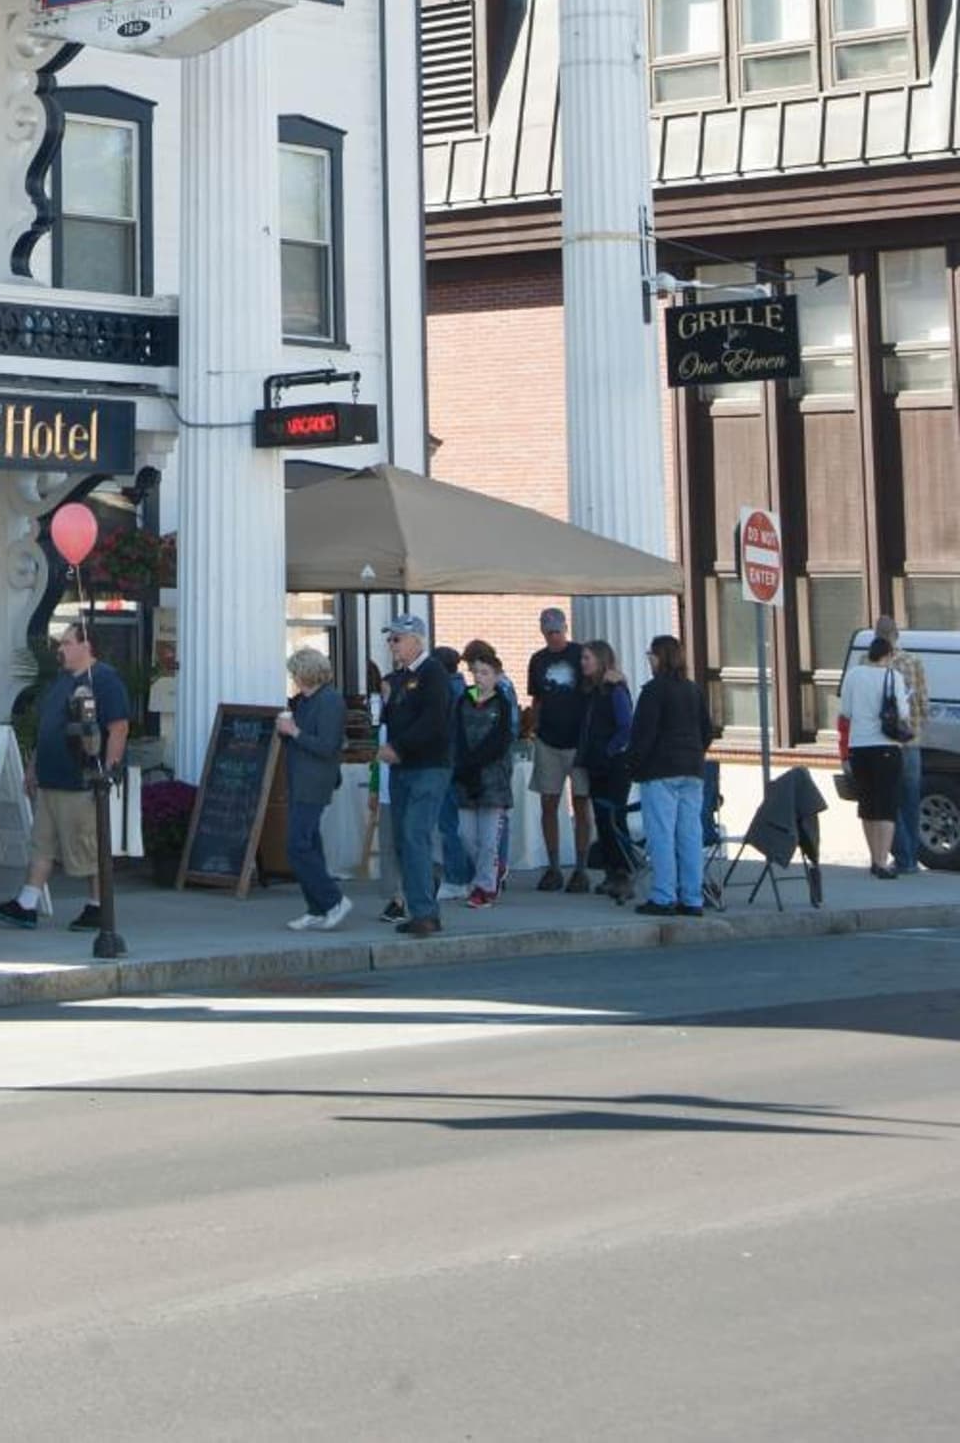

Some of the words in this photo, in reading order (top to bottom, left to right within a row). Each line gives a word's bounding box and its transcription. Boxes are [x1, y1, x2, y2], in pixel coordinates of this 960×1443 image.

[678, 304, 784, 340] GRILLE
[678, 351, 719, 380] One
[722, 347, 786, 378] Eleven
[4, 404, 99, 462] Hotel
[746, 526, 761, 543] DO
[761, 530, 778, 547] NOT
[749, 565, 776, 587] ENTER
